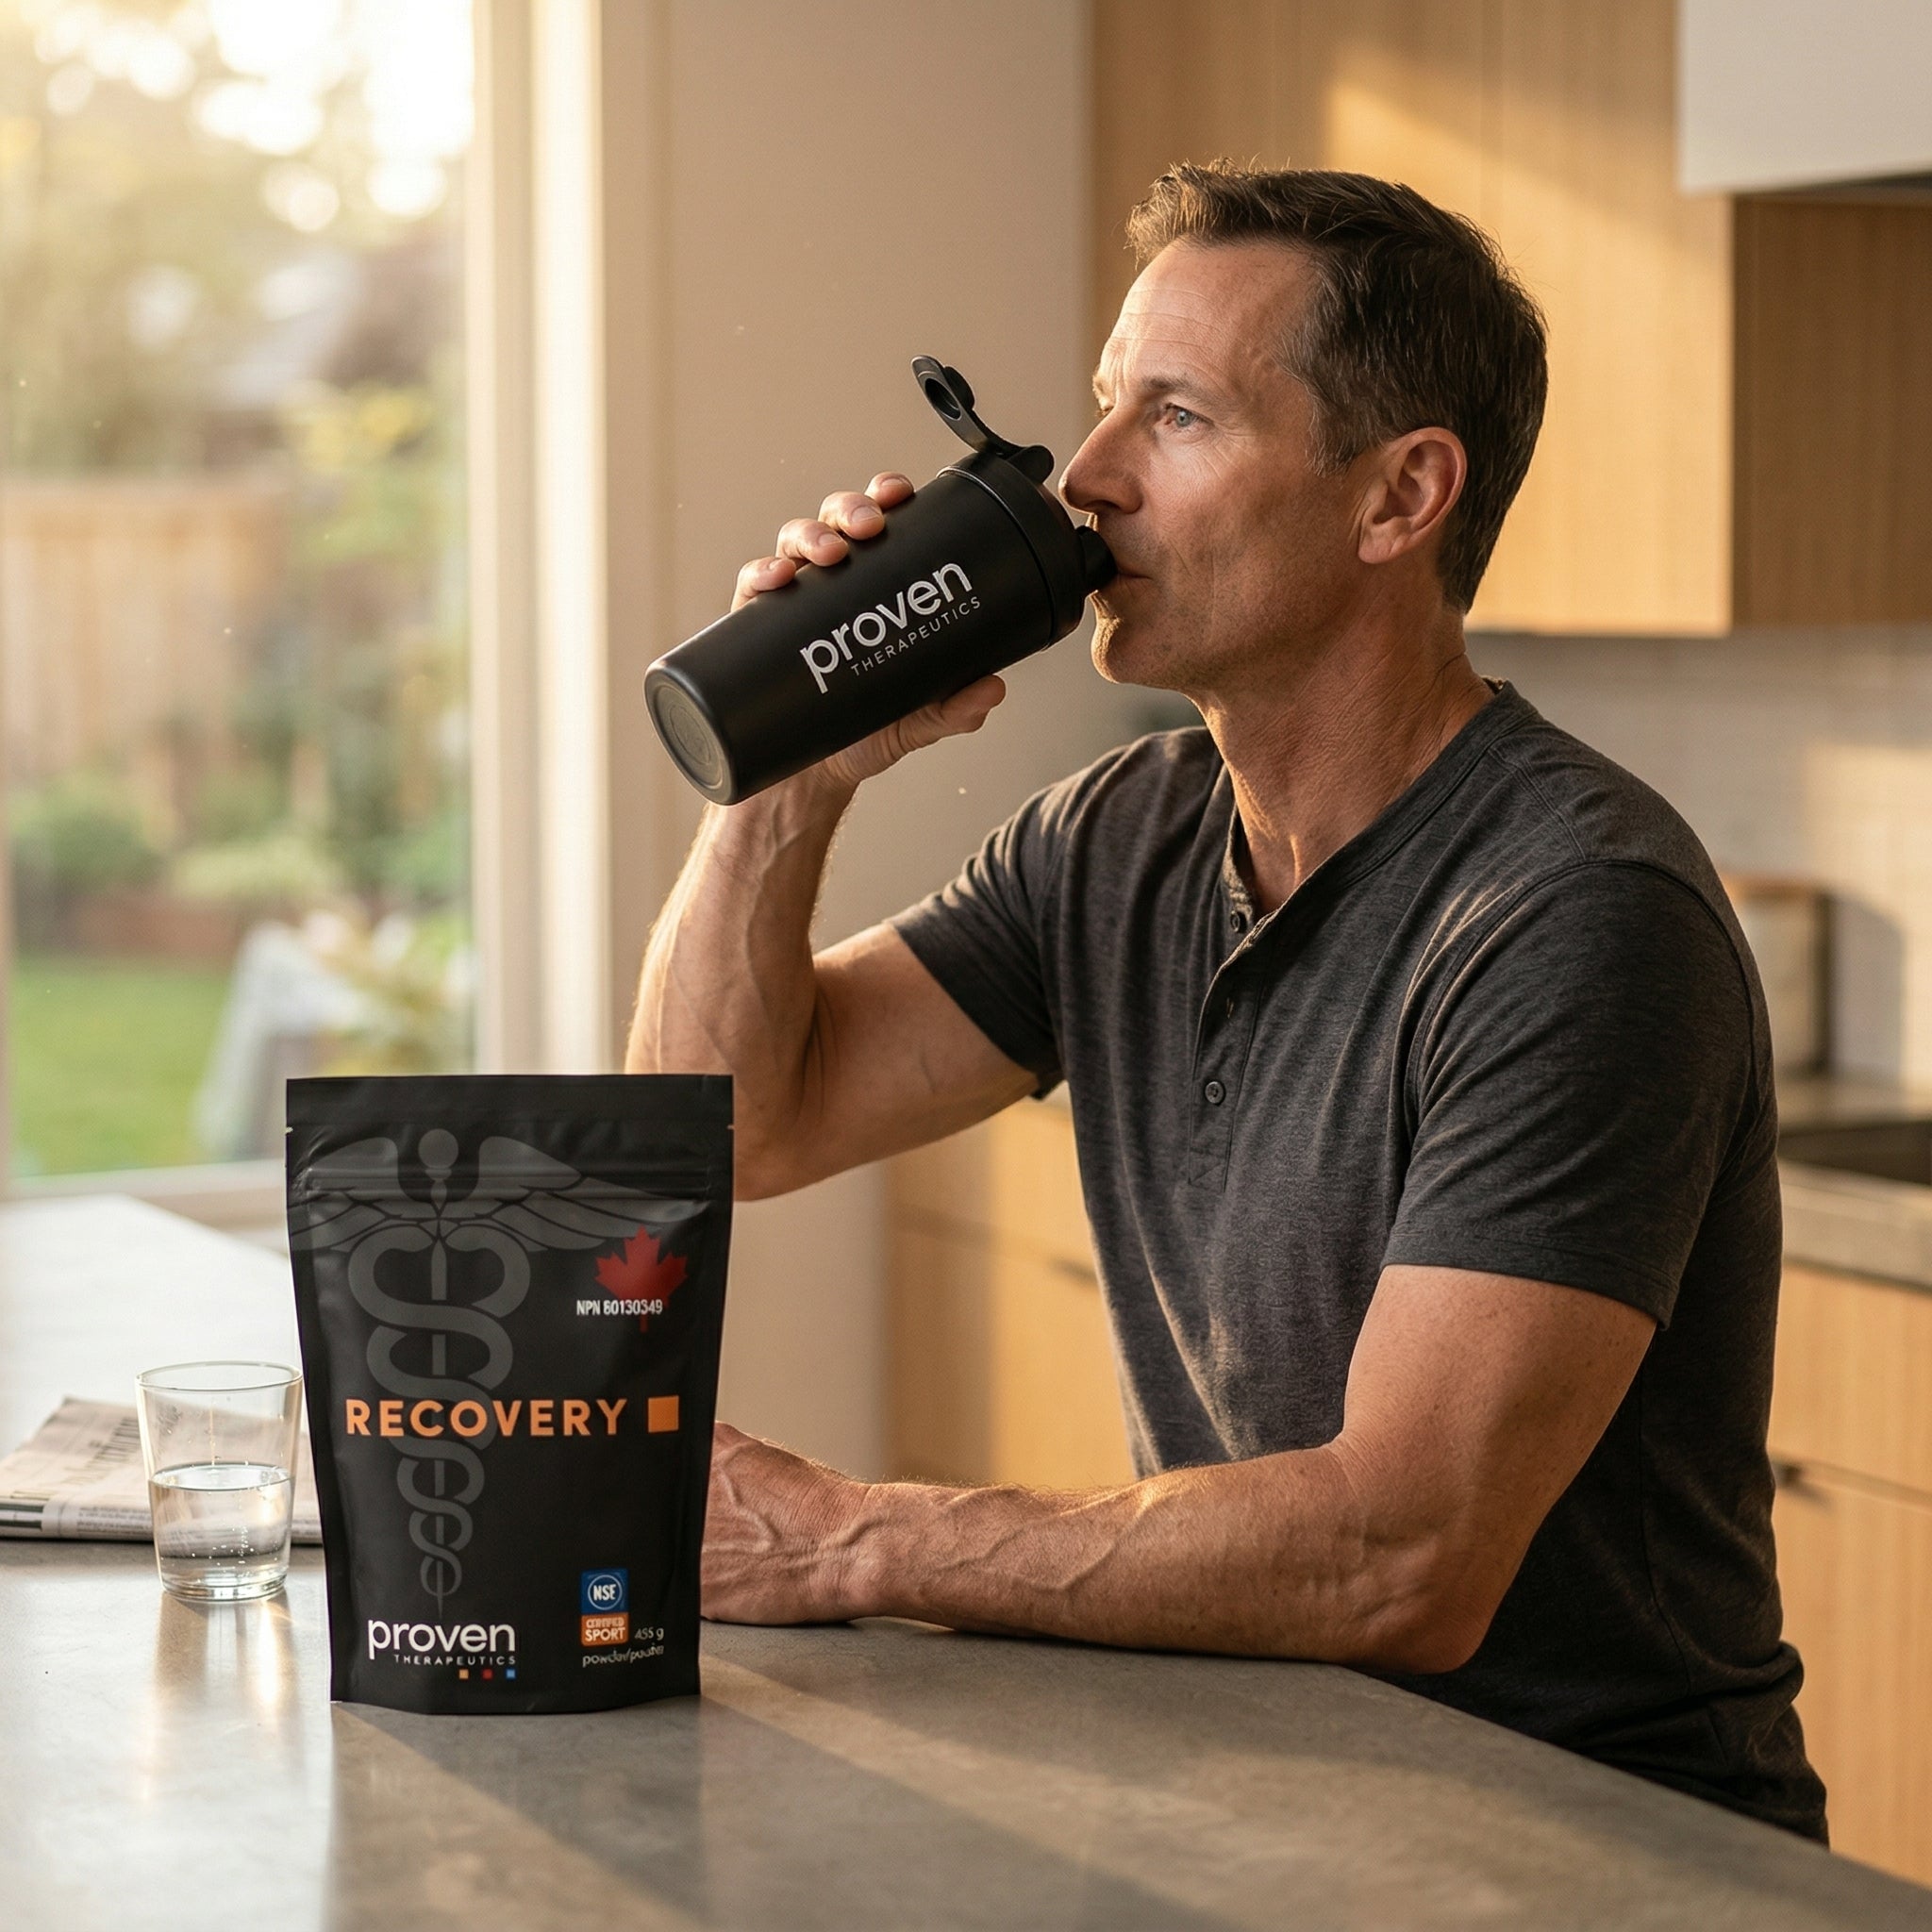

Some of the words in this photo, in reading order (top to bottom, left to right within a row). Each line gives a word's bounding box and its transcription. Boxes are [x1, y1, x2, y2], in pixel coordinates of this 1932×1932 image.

[800, 563, 973, 694] proven
[850, 596, 981, 676] THERAPEUTICS
[576, 1300, 601, 1316] NPN
[345, 1399, 627, 1437] RECOVERY
[368, 1620, 516, 1660] proven
[585, 1627, 625, 1641] SPORT
[393, 1654, 516, 1666] THERAPEUTICS
